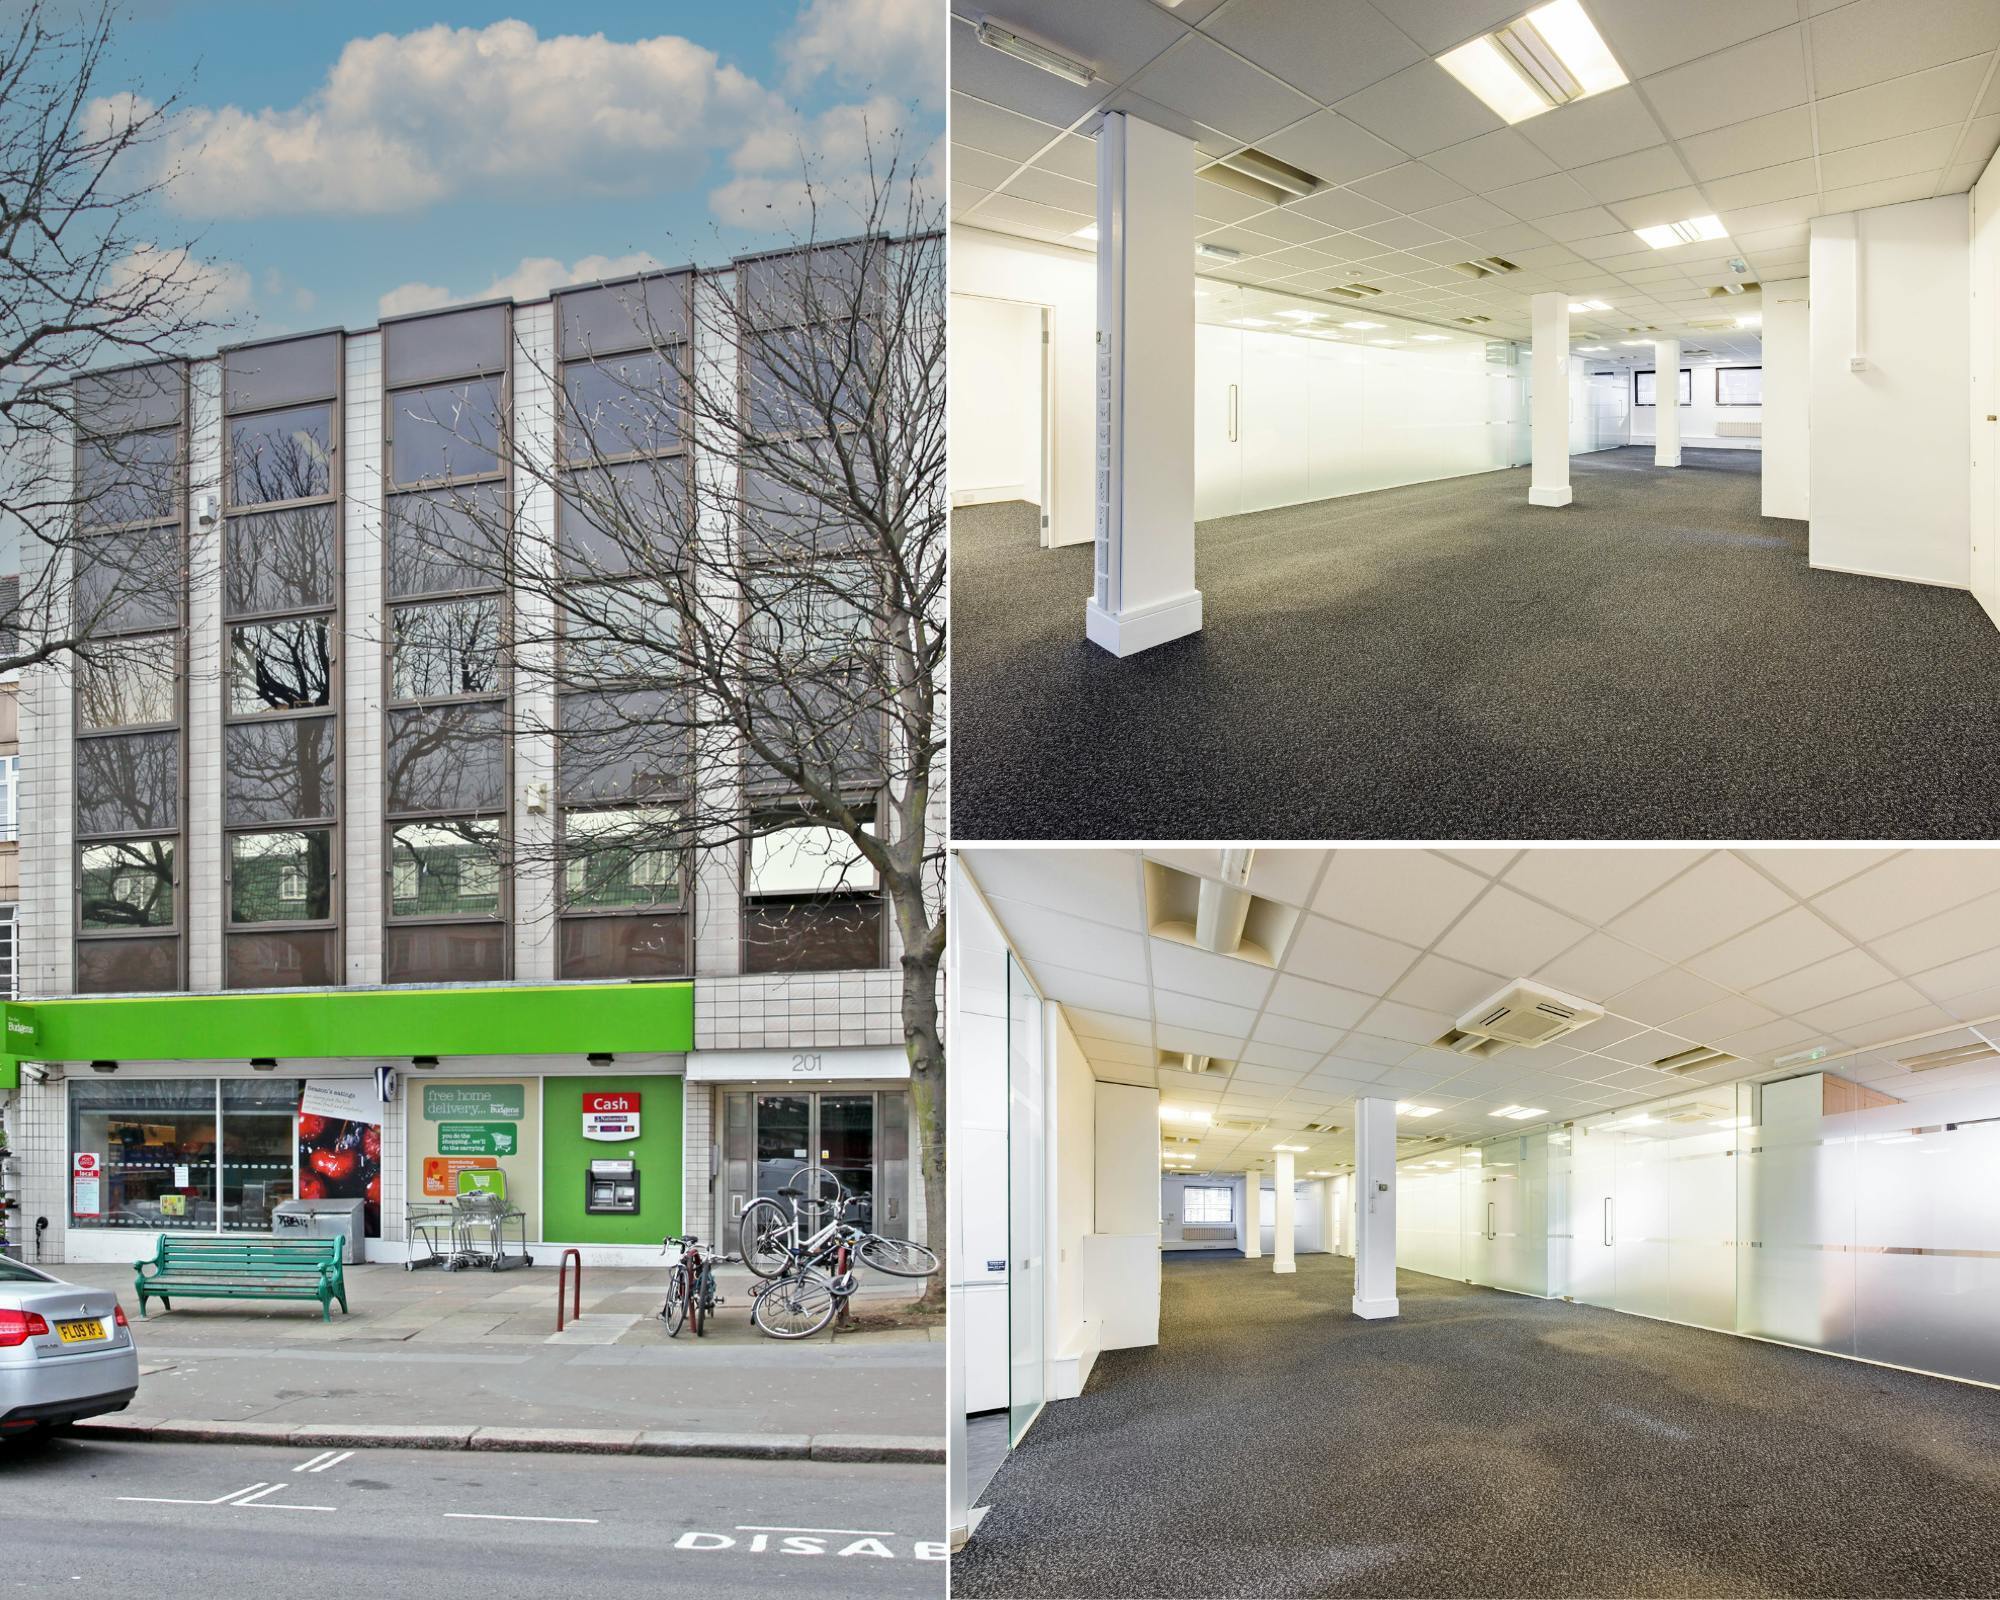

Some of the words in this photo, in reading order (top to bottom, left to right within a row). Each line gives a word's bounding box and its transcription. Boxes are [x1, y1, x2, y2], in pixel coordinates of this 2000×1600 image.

[792, 1054, 822, 1071] 201
[428, 1090, 454, 1101] free
[458, 1090, 492, 1101] home
[428, 1102, 486, 1116] delivery...
[593, 1097, 629, 1110] Cash
[60, 1324, 87, 1340] FL09
